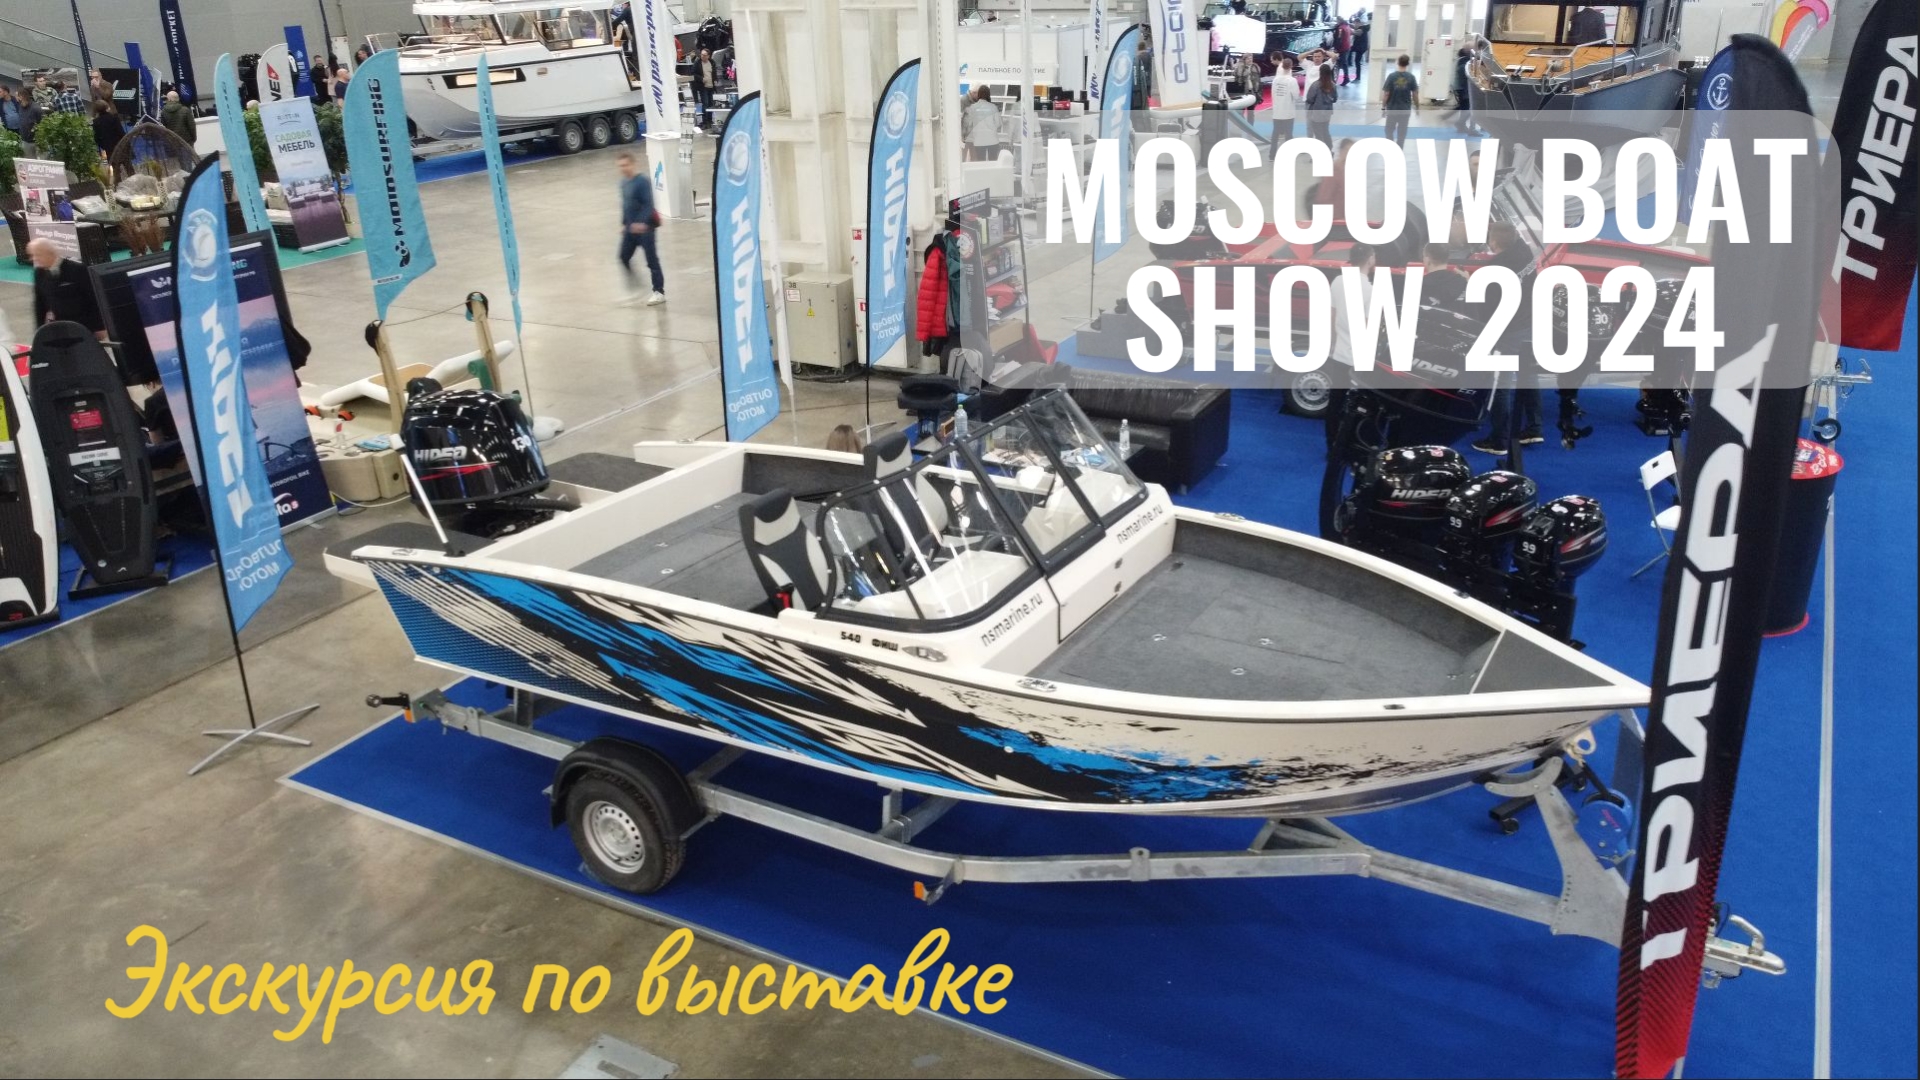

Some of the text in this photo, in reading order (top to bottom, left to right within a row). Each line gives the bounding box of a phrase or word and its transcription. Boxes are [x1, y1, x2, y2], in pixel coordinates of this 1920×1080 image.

[1012, 66, 1046, 75] ПОТИЕ
[275, 130, 312, 143] САДОВАЯ
[278, 140, 316, 153] МЕБЕЛЬ
[1831, 35, 1918, 284] ТРИЕРА
[414, 446, 468, 462] HIDEA
[1391, 489, 1452, 499] HIDEA
[1117, 504, 1163, 544] nsmarine.ru
[981, 592, 1043, 647] nsmarine.ru
[840, 631, 899, 651] 540 ФИШ
